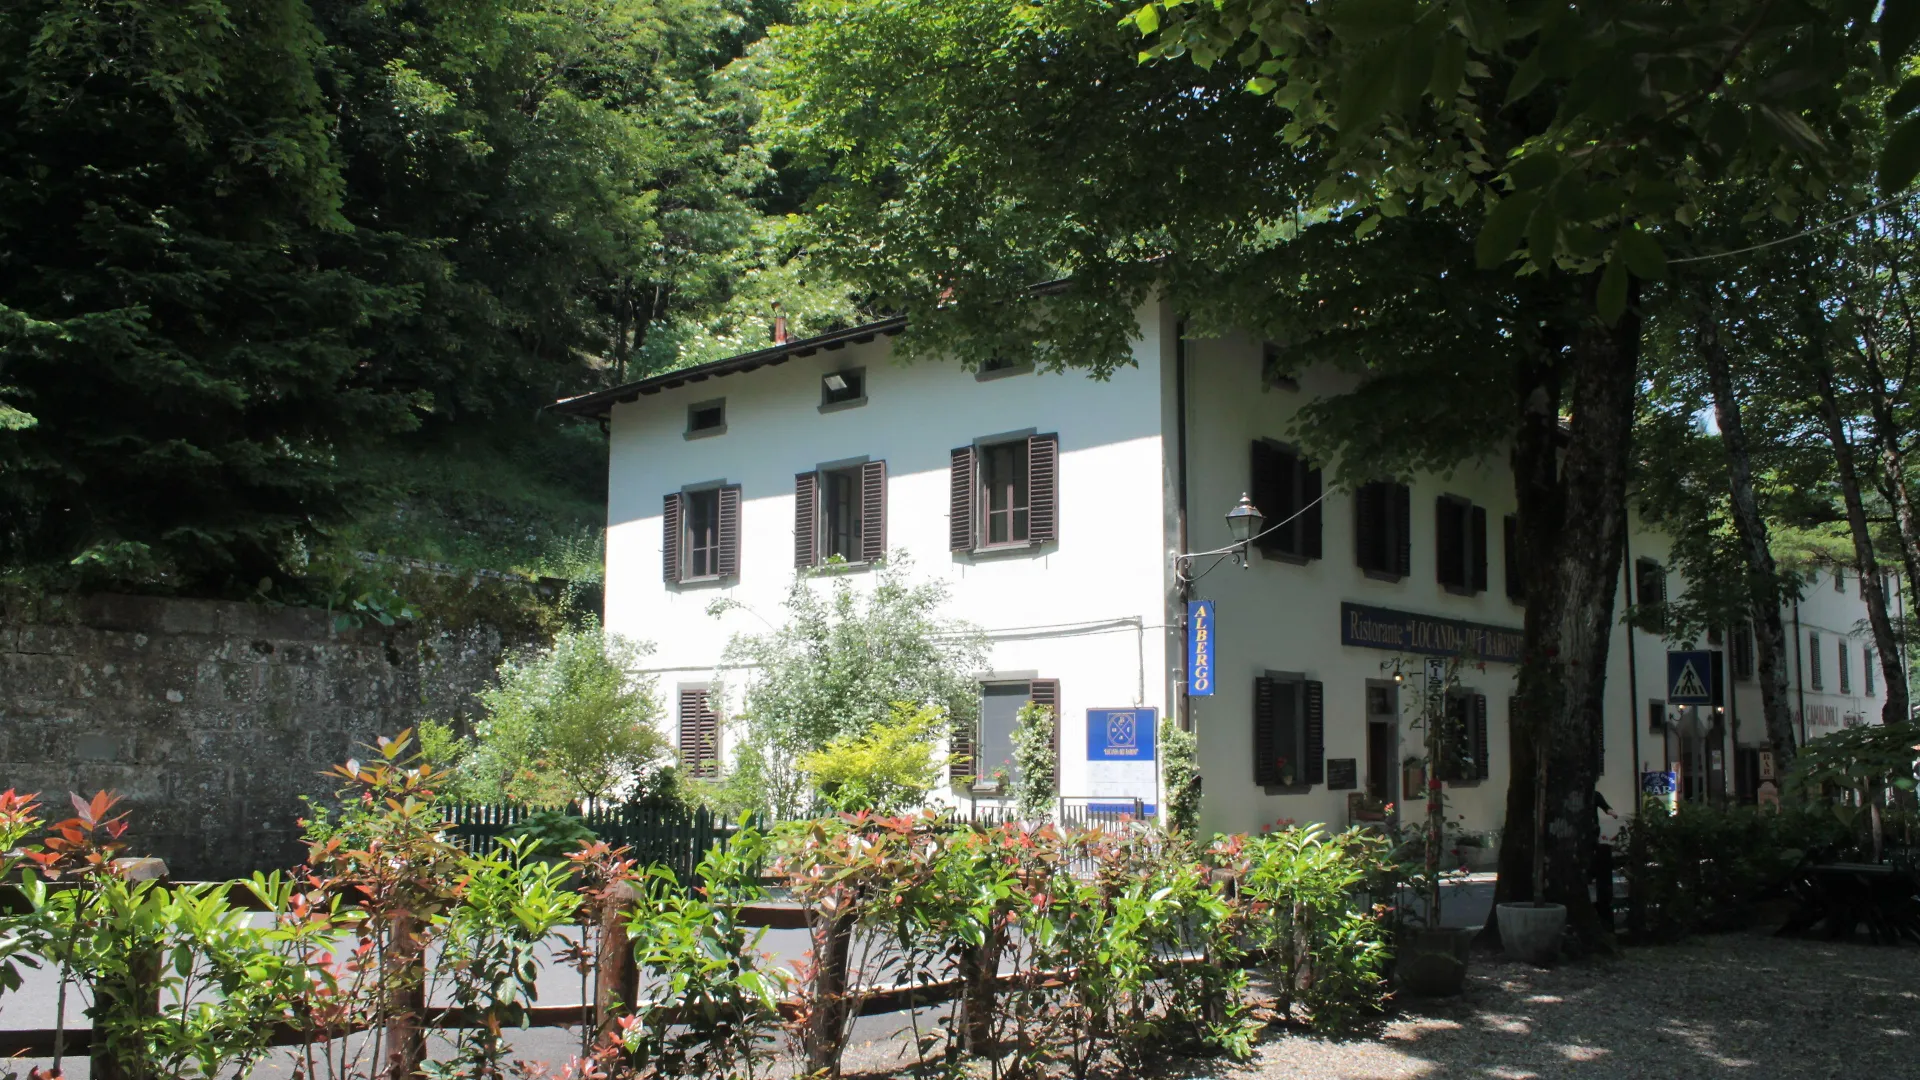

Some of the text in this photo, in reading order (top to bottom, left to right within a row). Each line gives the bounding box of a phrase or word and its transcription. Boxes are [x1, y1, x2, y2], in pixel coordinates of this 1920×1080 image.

[1350, 610, 1403, 645] Ristorante
[1194, 605, 1209, 690] ALBERGO
[1763, 753, 1771, 775] BAR
[1646, 785, 1672, 795] BAR
